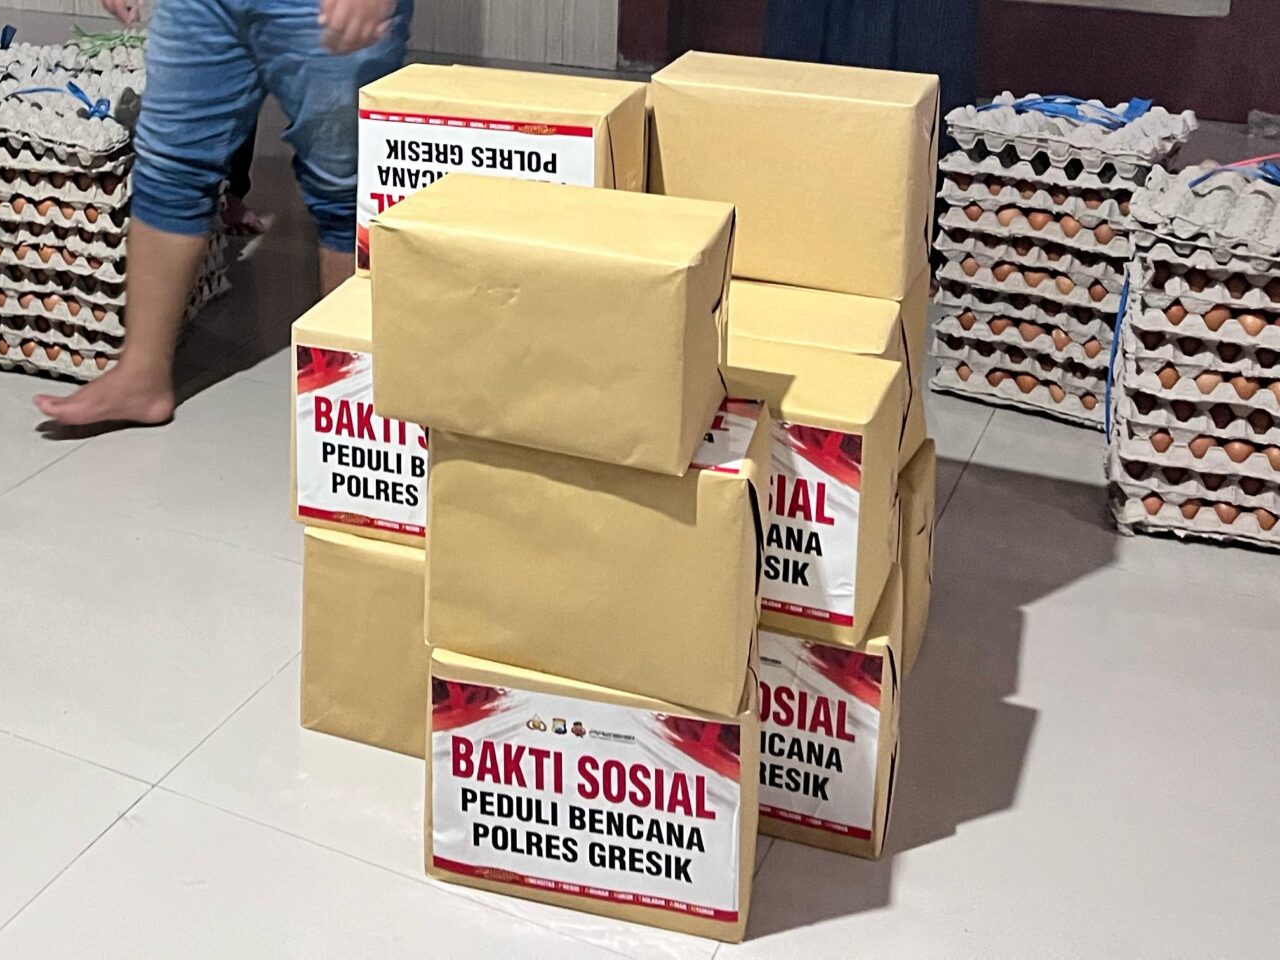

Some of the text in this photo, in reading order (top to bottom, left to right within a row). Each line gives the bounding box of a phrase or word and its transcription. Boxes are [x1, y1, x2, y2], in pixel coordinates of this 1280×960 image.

[386, 139, 557, 174] POLRES GRESIK
[322, 441, 403, 475] PEDULI
[332, 472, 419, 507] POLRES
[451, 735, 563, 794] BAKTI
[577, 755, 716, 820] SOSIAL
[461, 787, 705, 853] PEDULI BENCANA
[473, 822, 693, 884] POLRES GRESIK
